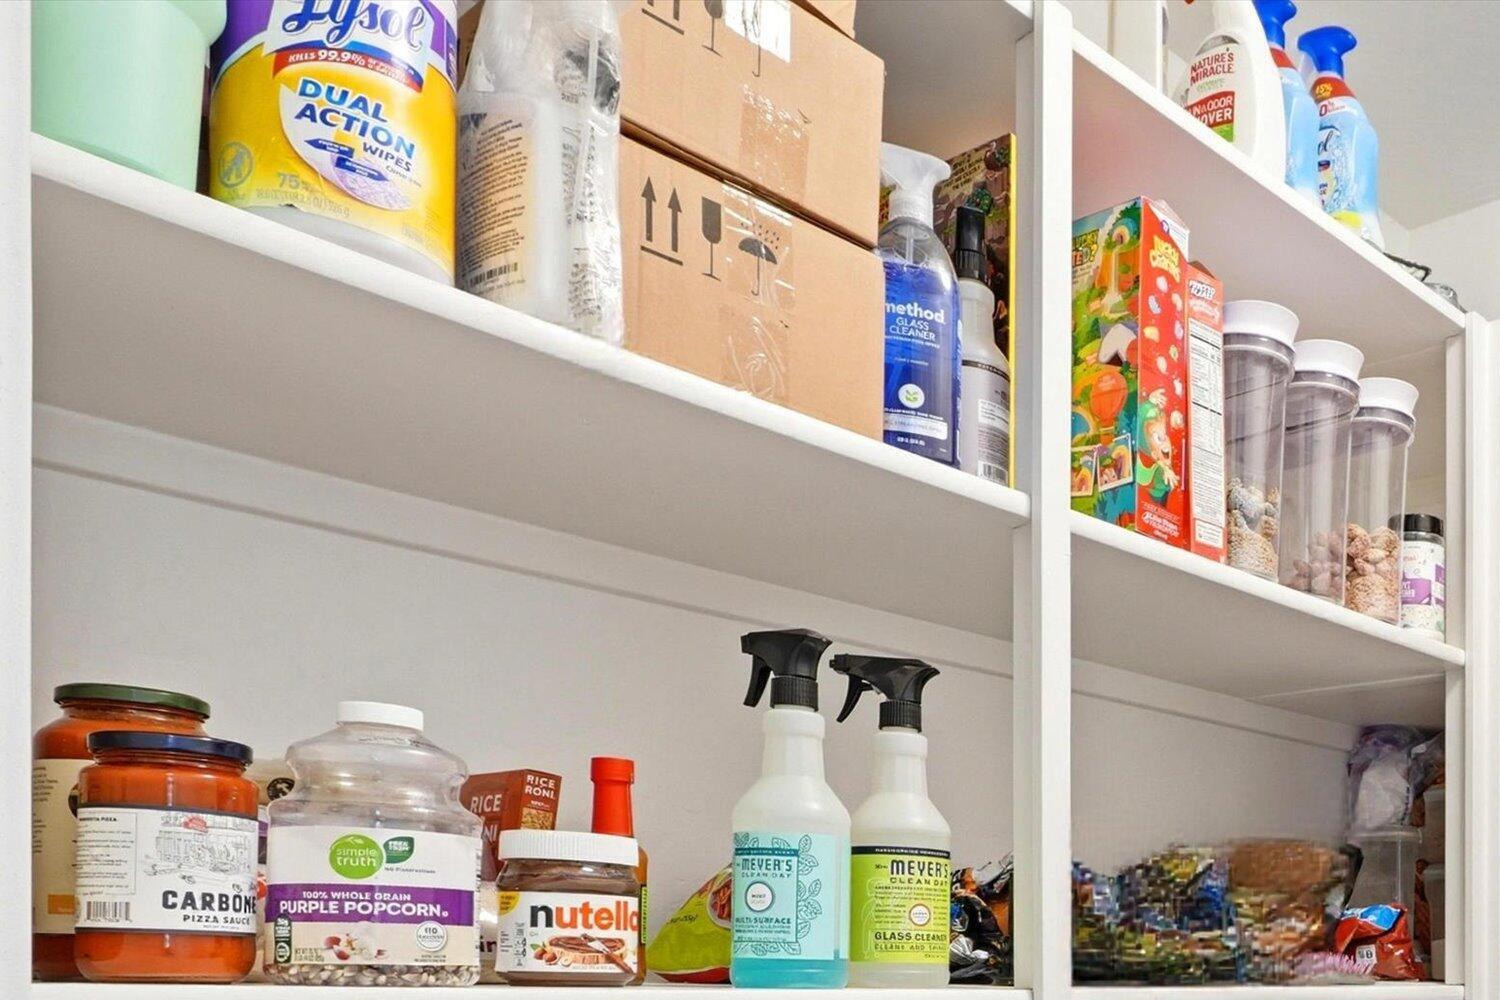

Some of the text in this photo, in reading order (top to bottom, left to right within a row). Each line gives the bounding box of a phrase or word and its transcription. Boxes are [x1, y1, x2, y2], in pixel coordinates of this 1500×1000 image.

[1190, 50, 1235, 75] NATURE'S
[1190, 63, 1235, 87] MIRACLE
[298, 78, 388, 123] DUAL
[1207, 94, 1234, 112] ODOR
[294, 103, 416, 160] ACTION
[362, 142, 413, 173] WIPES
[896, 317, 930, 331] GLASS
[889, 326, 936, 342] CLEANER
[526, 774, 556, 790] RICE
[470, 794, 502, 814] RICE
[336, 846, 379, 859] simple
[336, 856, 377, 868] truth
[741, 858, 793, 872] MEYER'S
[890, 859, 949, 878] MEYER'S
[890, 877, 931, 886] CLEAN
[161, 889, 258, 916] CARBONE
[302, 890, 411, 902] 100% WHOLE GRAIN
[280, 900, 441, 918] PURPLE POPCORN
[183, 914, 251, 926] PIZZA SAUCE
[874, 931, 912, 941] GLASS
